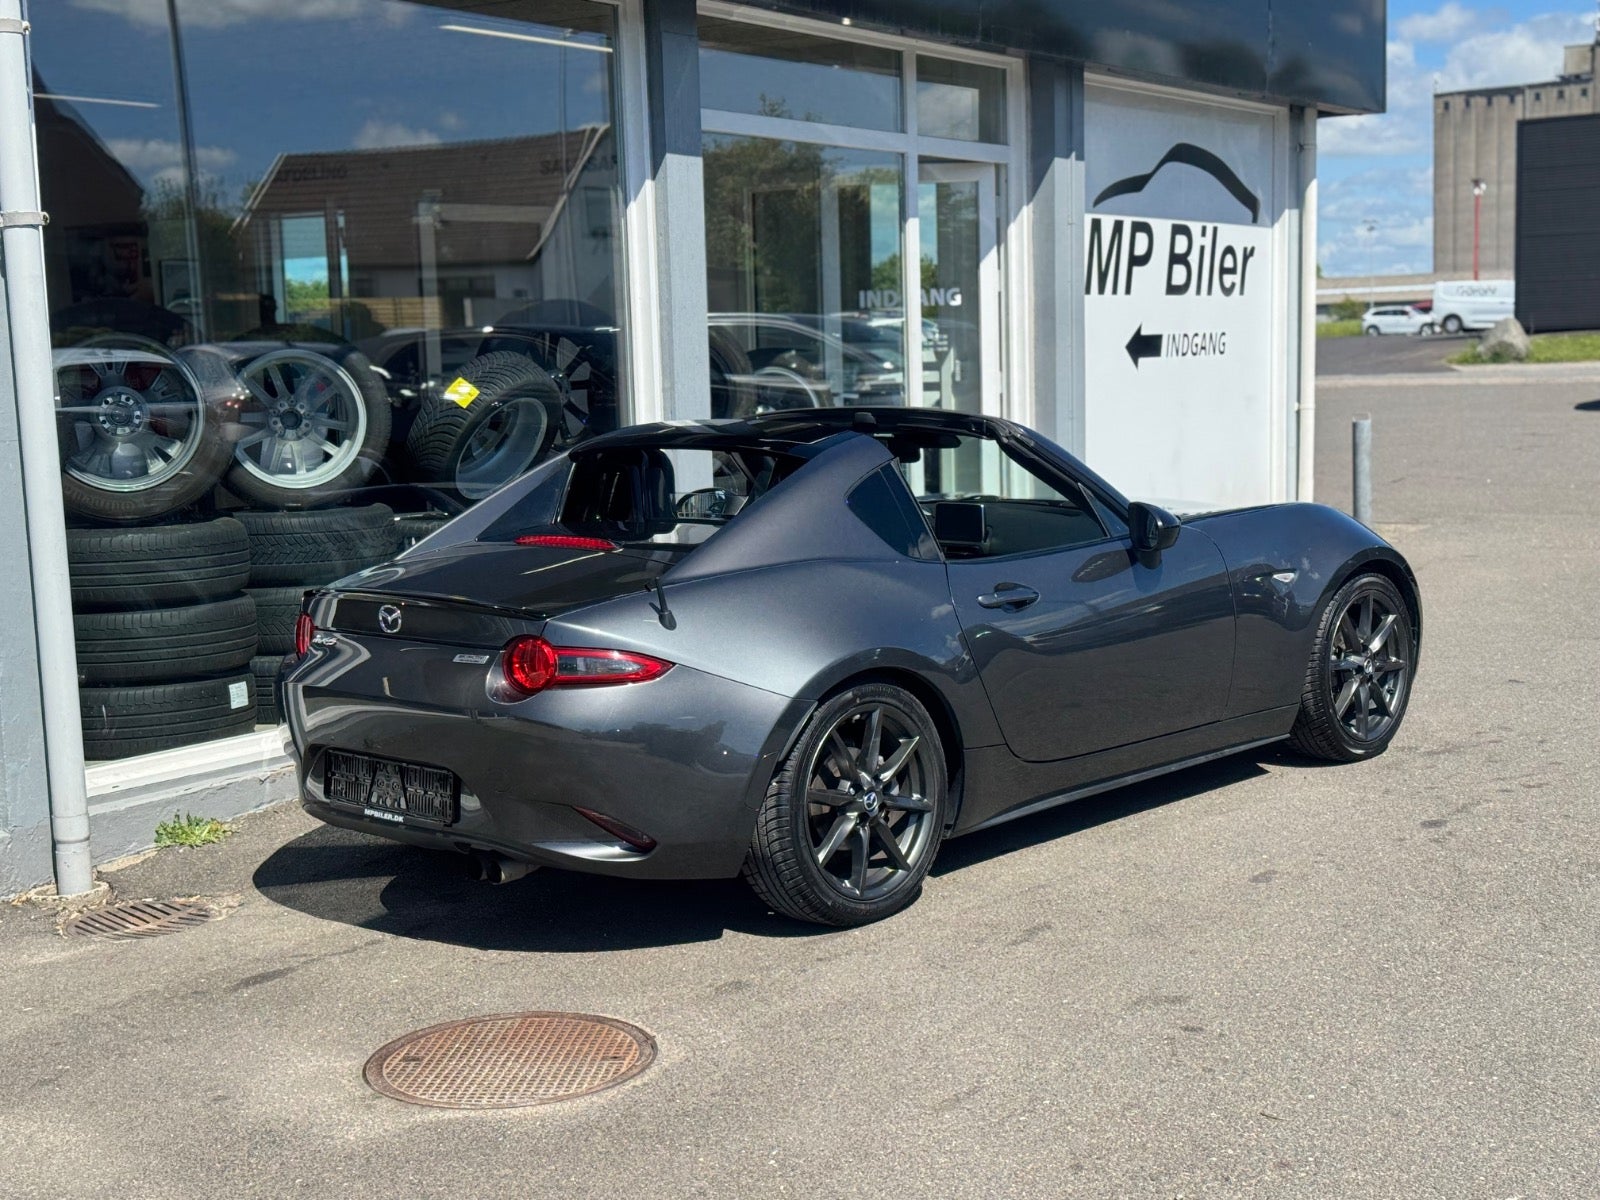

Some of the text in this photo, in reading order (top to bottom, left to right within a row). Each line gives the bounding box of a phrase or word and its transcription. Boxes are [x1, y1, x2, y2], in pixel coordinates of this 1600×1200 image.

[1084, 217, 1256, 297] MP Biler
[858, 287, 962, 310] INDANG
[1165, 332, 1226, 358] INDGANG
